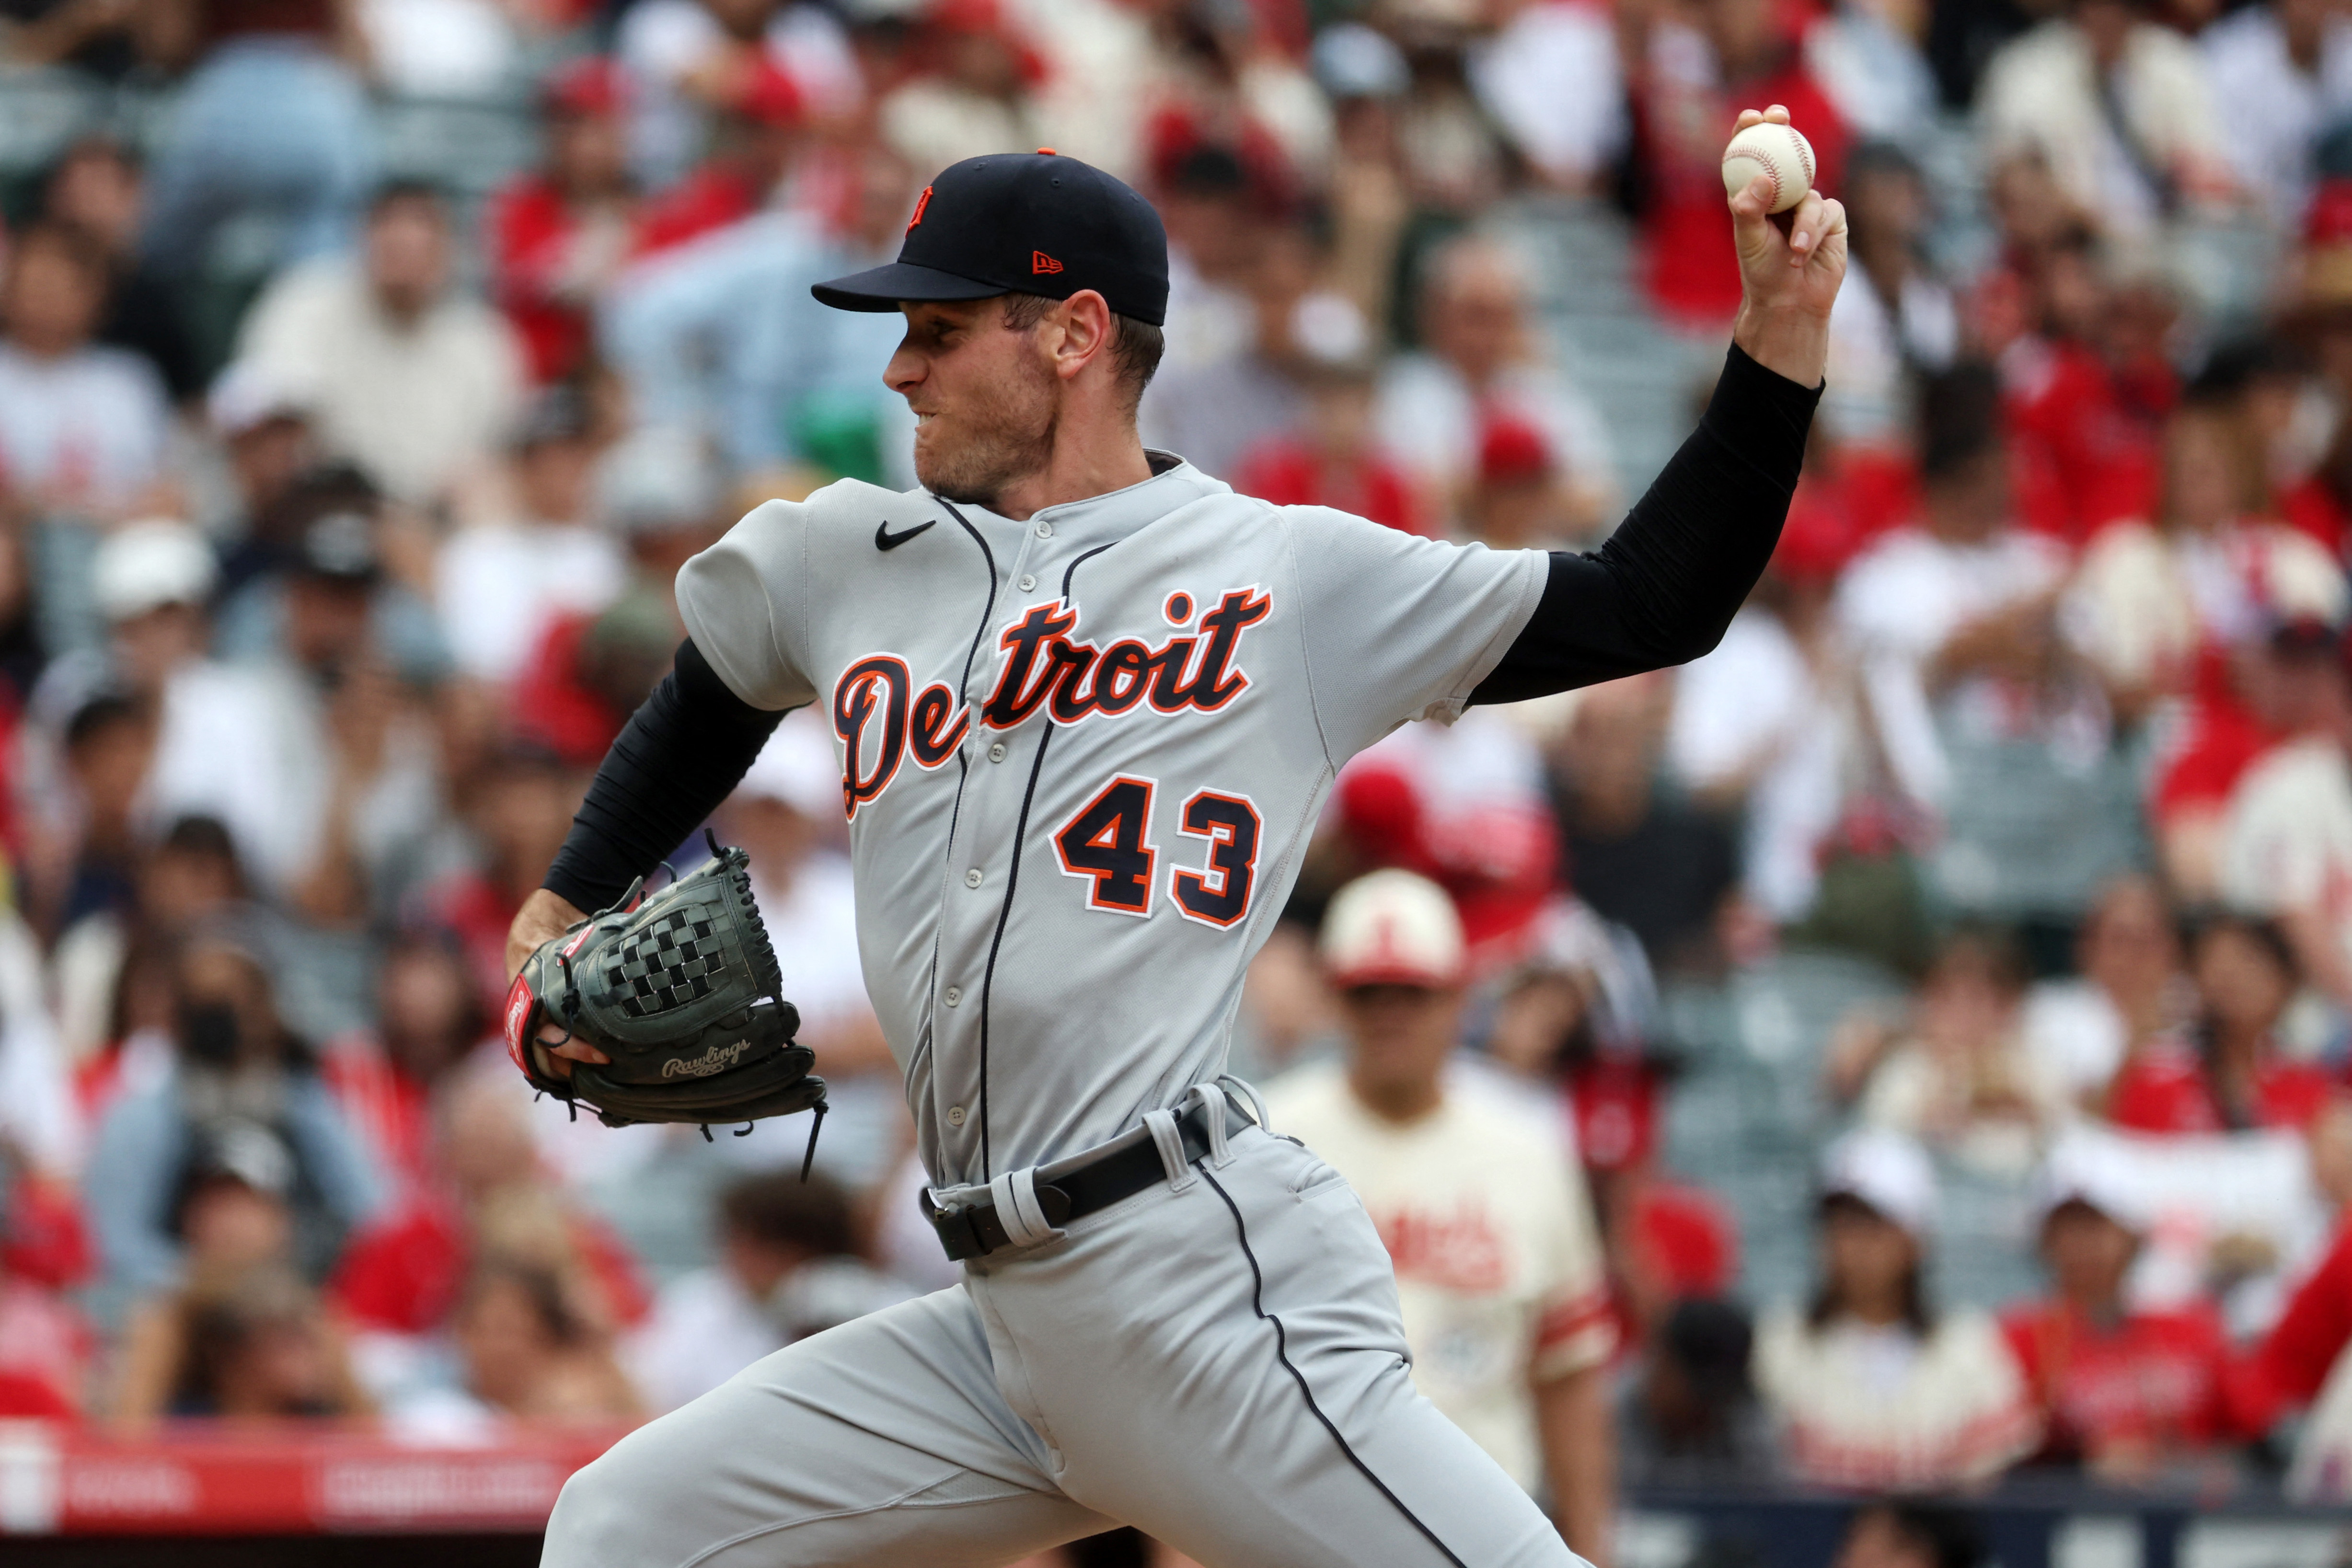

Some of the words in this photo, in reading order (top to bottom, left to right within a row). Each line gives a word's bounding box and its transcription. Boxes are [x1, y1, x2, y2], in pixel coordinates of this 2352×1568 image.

[833, 583, 1272, 824] Detroit
[1048, 772, 1264, 932] 43
[662, 1039, 751, 1078] Rawlings
